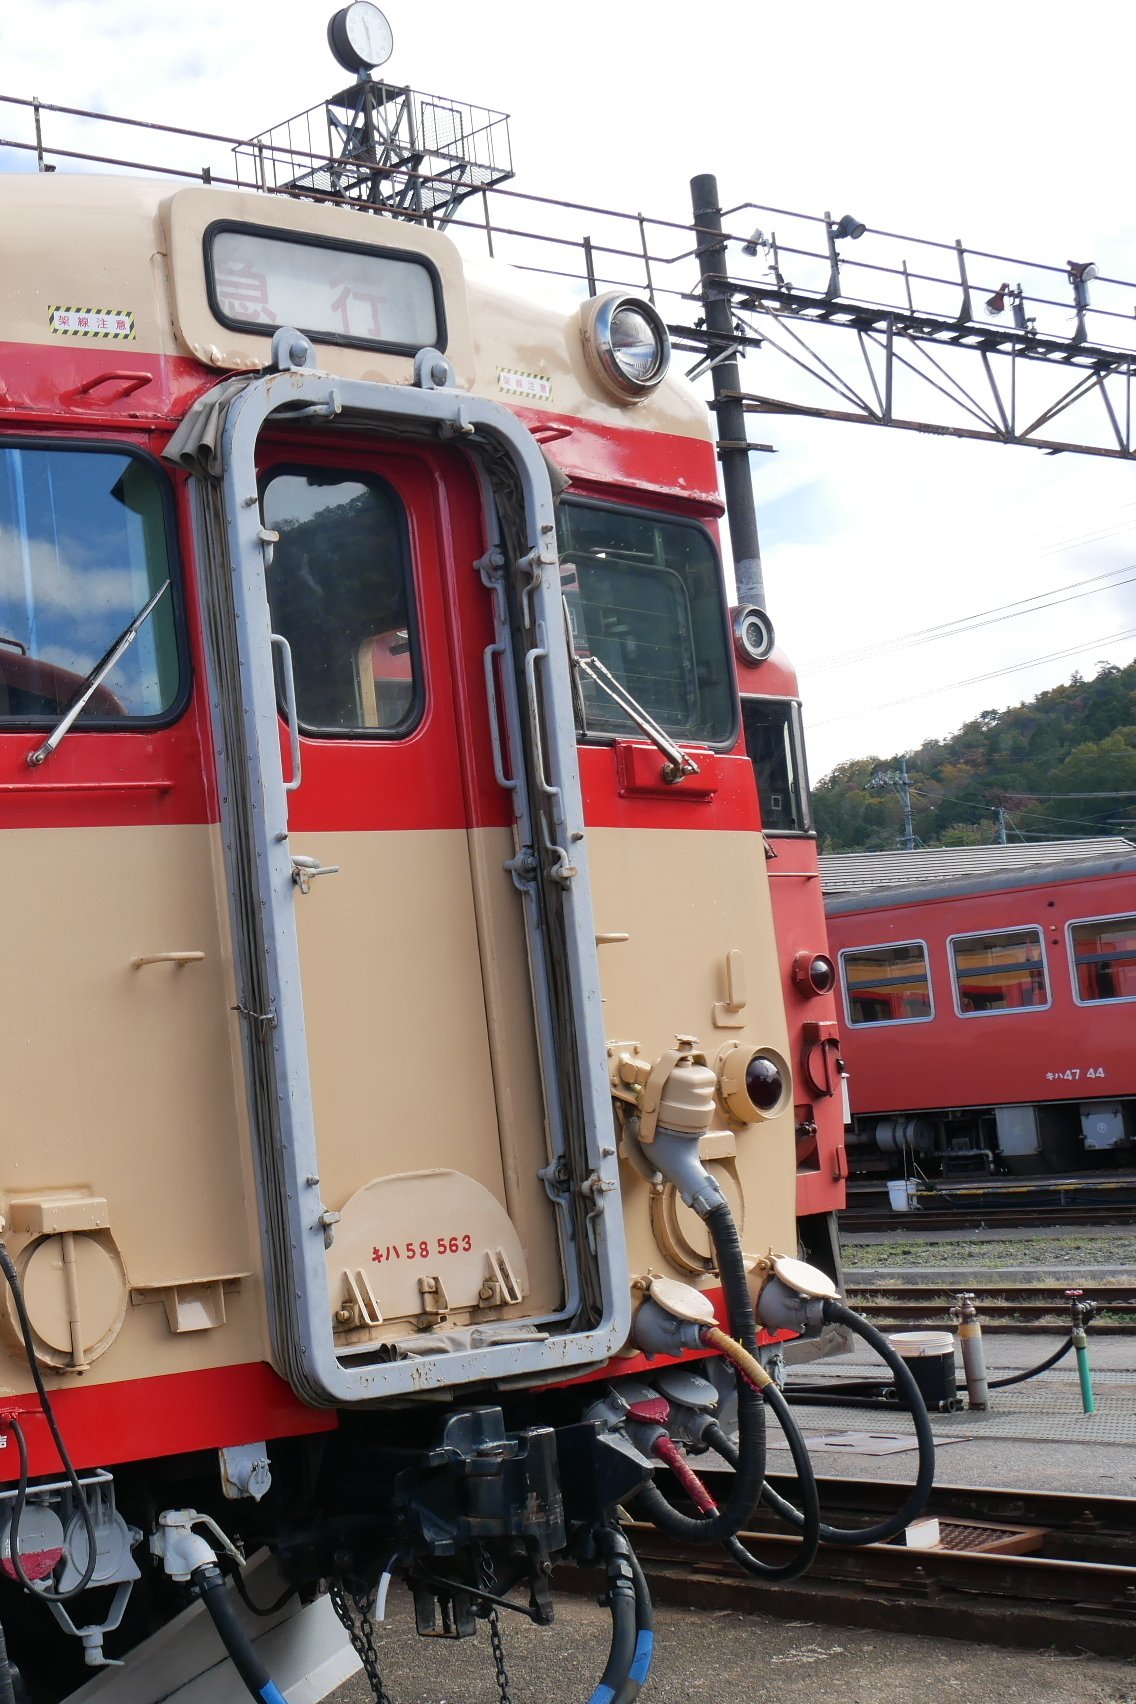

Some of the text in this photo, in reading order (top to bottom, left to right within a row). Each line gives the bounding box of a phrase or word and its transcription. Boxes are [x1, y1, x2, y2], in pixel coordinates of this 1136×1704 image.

[214, 257, 388, 338] 急行
[58, 315, 127, 331] 架線注意
[1086, 1067, 1105, 1079] 44
[436, 1234, 472, 1255] 563
